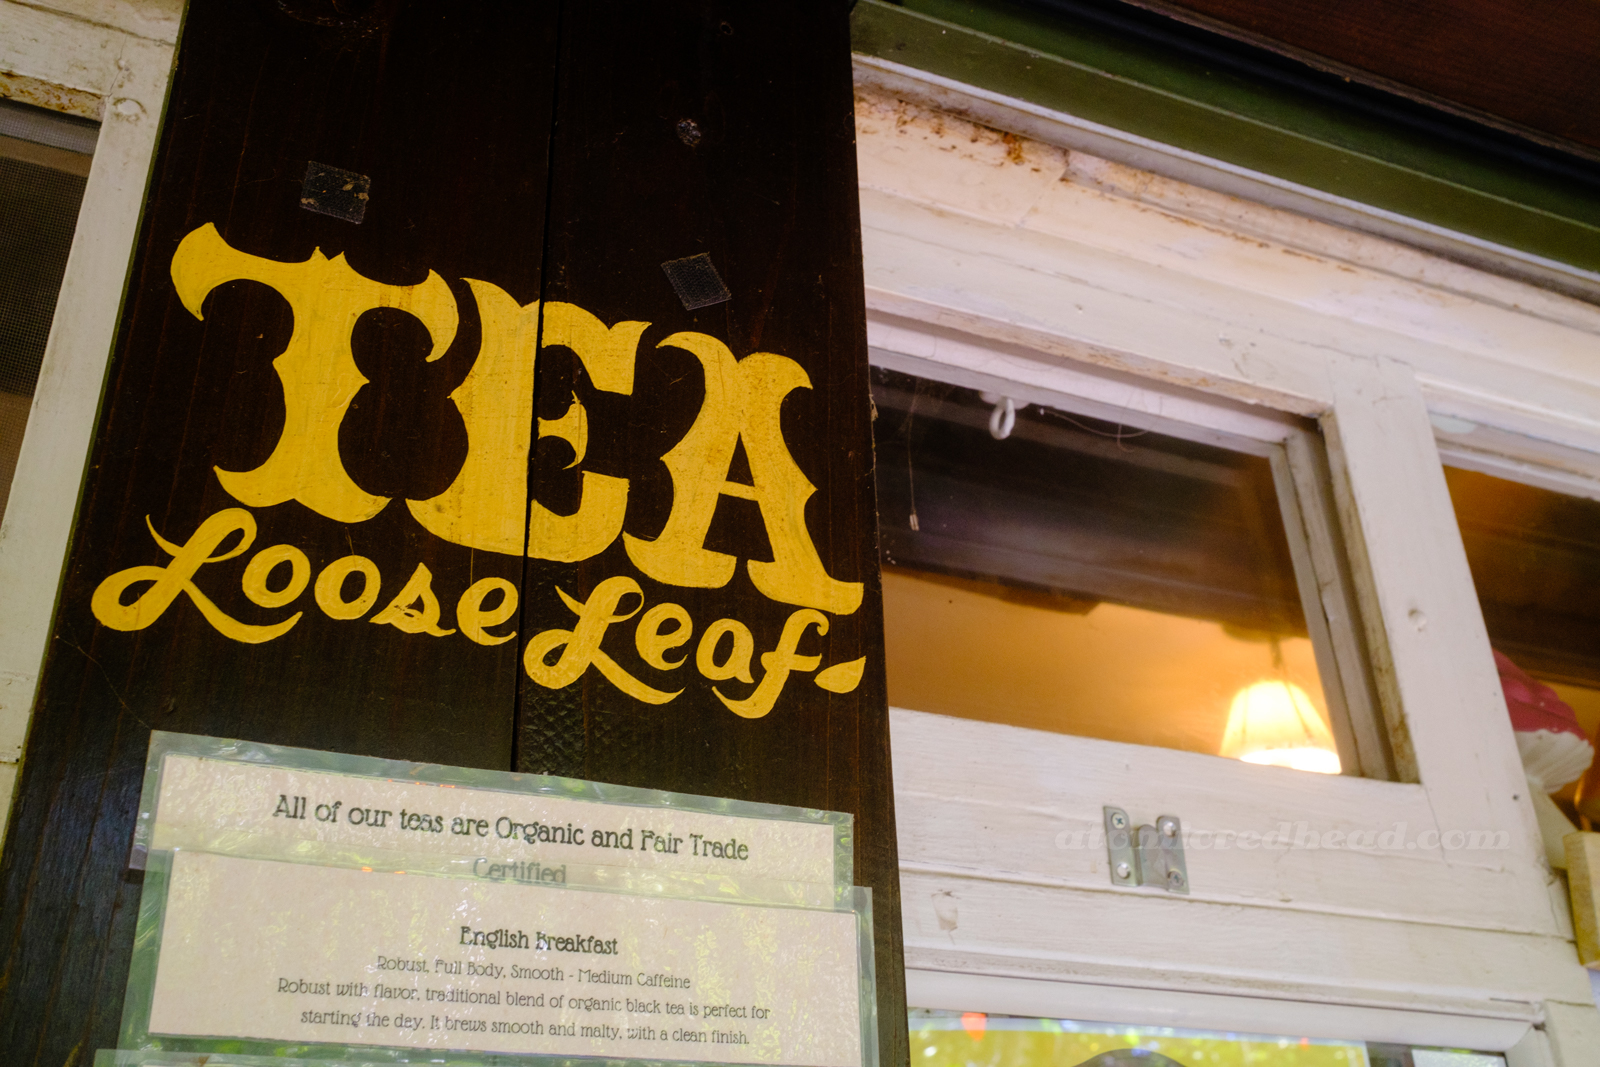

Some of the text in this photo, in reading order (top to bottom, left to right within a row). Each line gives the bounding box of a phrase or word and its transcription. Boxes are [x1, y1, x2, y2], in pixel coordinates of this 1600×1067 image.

[171, 222, 864, 616] TEA
[91, 507, 519, 647] Loose
[272, 794, 749, 861] All of our teas are Organic and Fair Trade
[472, 857, 567, 887] Certified
[459, 925, 619, 955] English Breakfast
[377, 955, 430, 974] Robust,
[435, 958, 462, 975] Full
[466, 961, 507, 979] Body,
[510, 963, 564, 981] Smooth
[577, 968, 633, 986] Medium
[636, 972, 691, 989] Caffeine
[277, 977, 771, 1020] Robust with flavor, traditional blend of organic black tea is perfect for
[300, 1008, 751, 1045] starting the day. It brews smooth and malty, with a clean finish.
